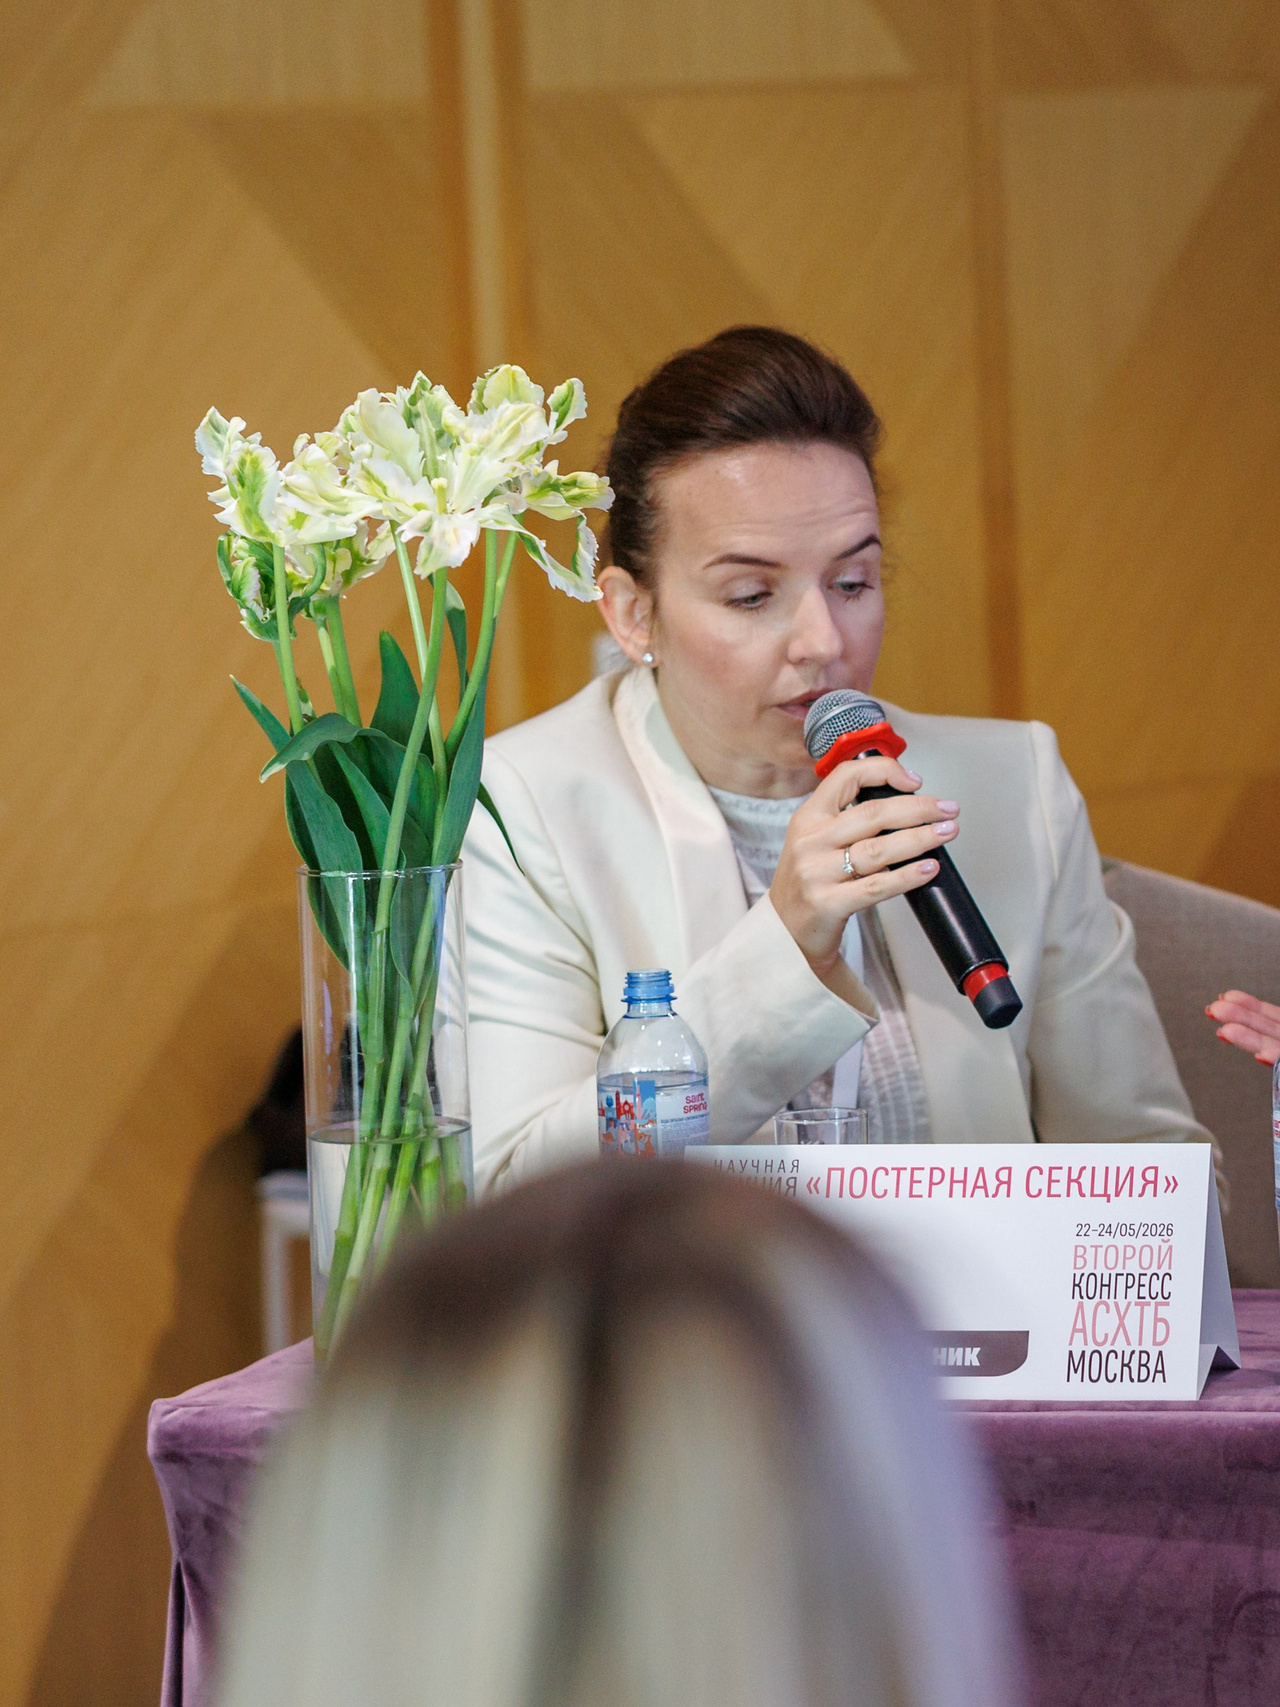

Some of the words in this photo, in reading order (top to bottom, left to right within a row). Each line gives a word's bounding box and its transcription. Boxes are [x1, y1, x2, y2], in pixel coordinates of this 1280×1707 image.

[714, 1159, 800, 1174] НАУЧНАЯ
[805, 1166, 1013, 1199] «ПОСТЕРНАЯ
[1025, 1165, 1179, 1203] СЕКЦИЯ»
[1072, 1238, 1174, 1271] ВТОРОЙ
[1071, 1272, 1173, 1300] КОНГРЕСС
[1068, 1300, 1171, 1347] АСХТБ
[933, 1347, 981, 1367] НИК
[1066, 1349, 1167, 1384] МОСКВА
